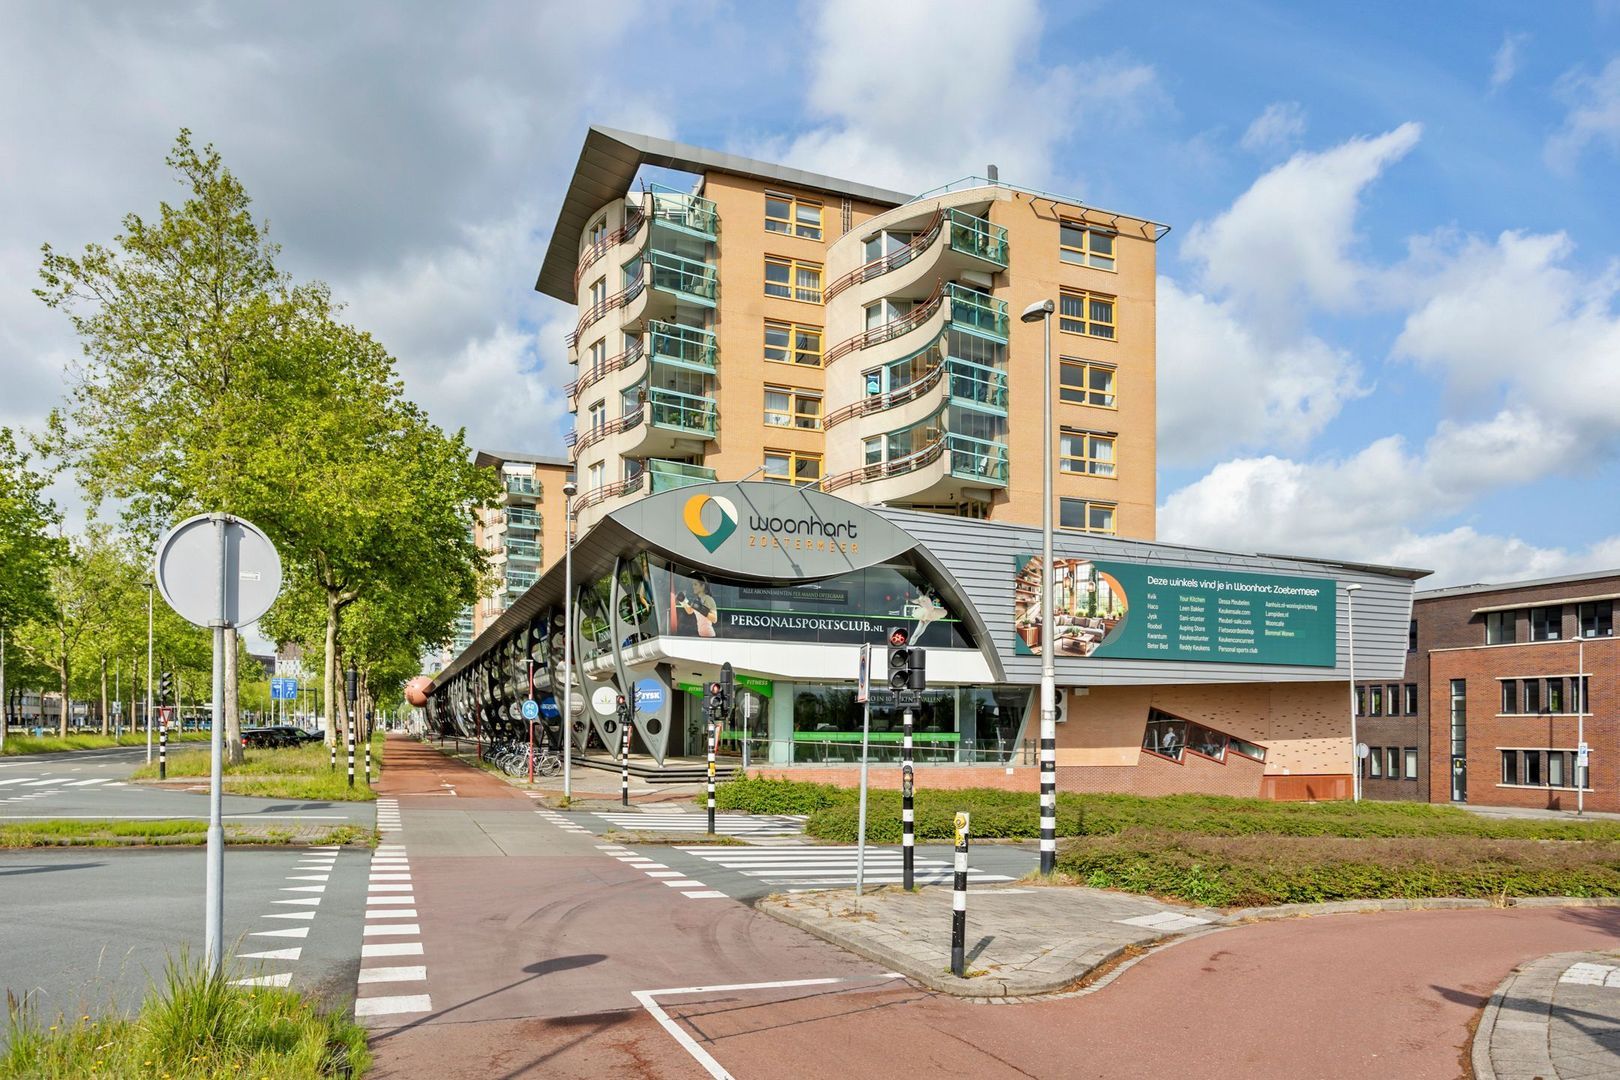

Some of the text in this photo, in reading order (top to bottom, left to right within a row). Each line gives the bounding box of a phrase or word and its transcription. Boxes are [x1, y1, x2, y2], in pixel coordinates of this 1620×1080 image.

[749, 516, 858, 539] woonhart
[748, 536, 858, 553] ZOETERMEER
[1147, 575, 1320, 597] Deze winkels vind je in Woonhart Zoetermeer
[1147, 612, 1158, 621] Jysk
[731, 614, 884, 633] PERSONALSPORTSCLUB.NL
[1179, 625, 1194, 633] Auping
[1147, 632, 1168, 640] Kwantum
[1147, 642, 1159, 650] Beter
[1218, 645, 1236, 653] Personal
[641, 691, 660, 700] JYSK
